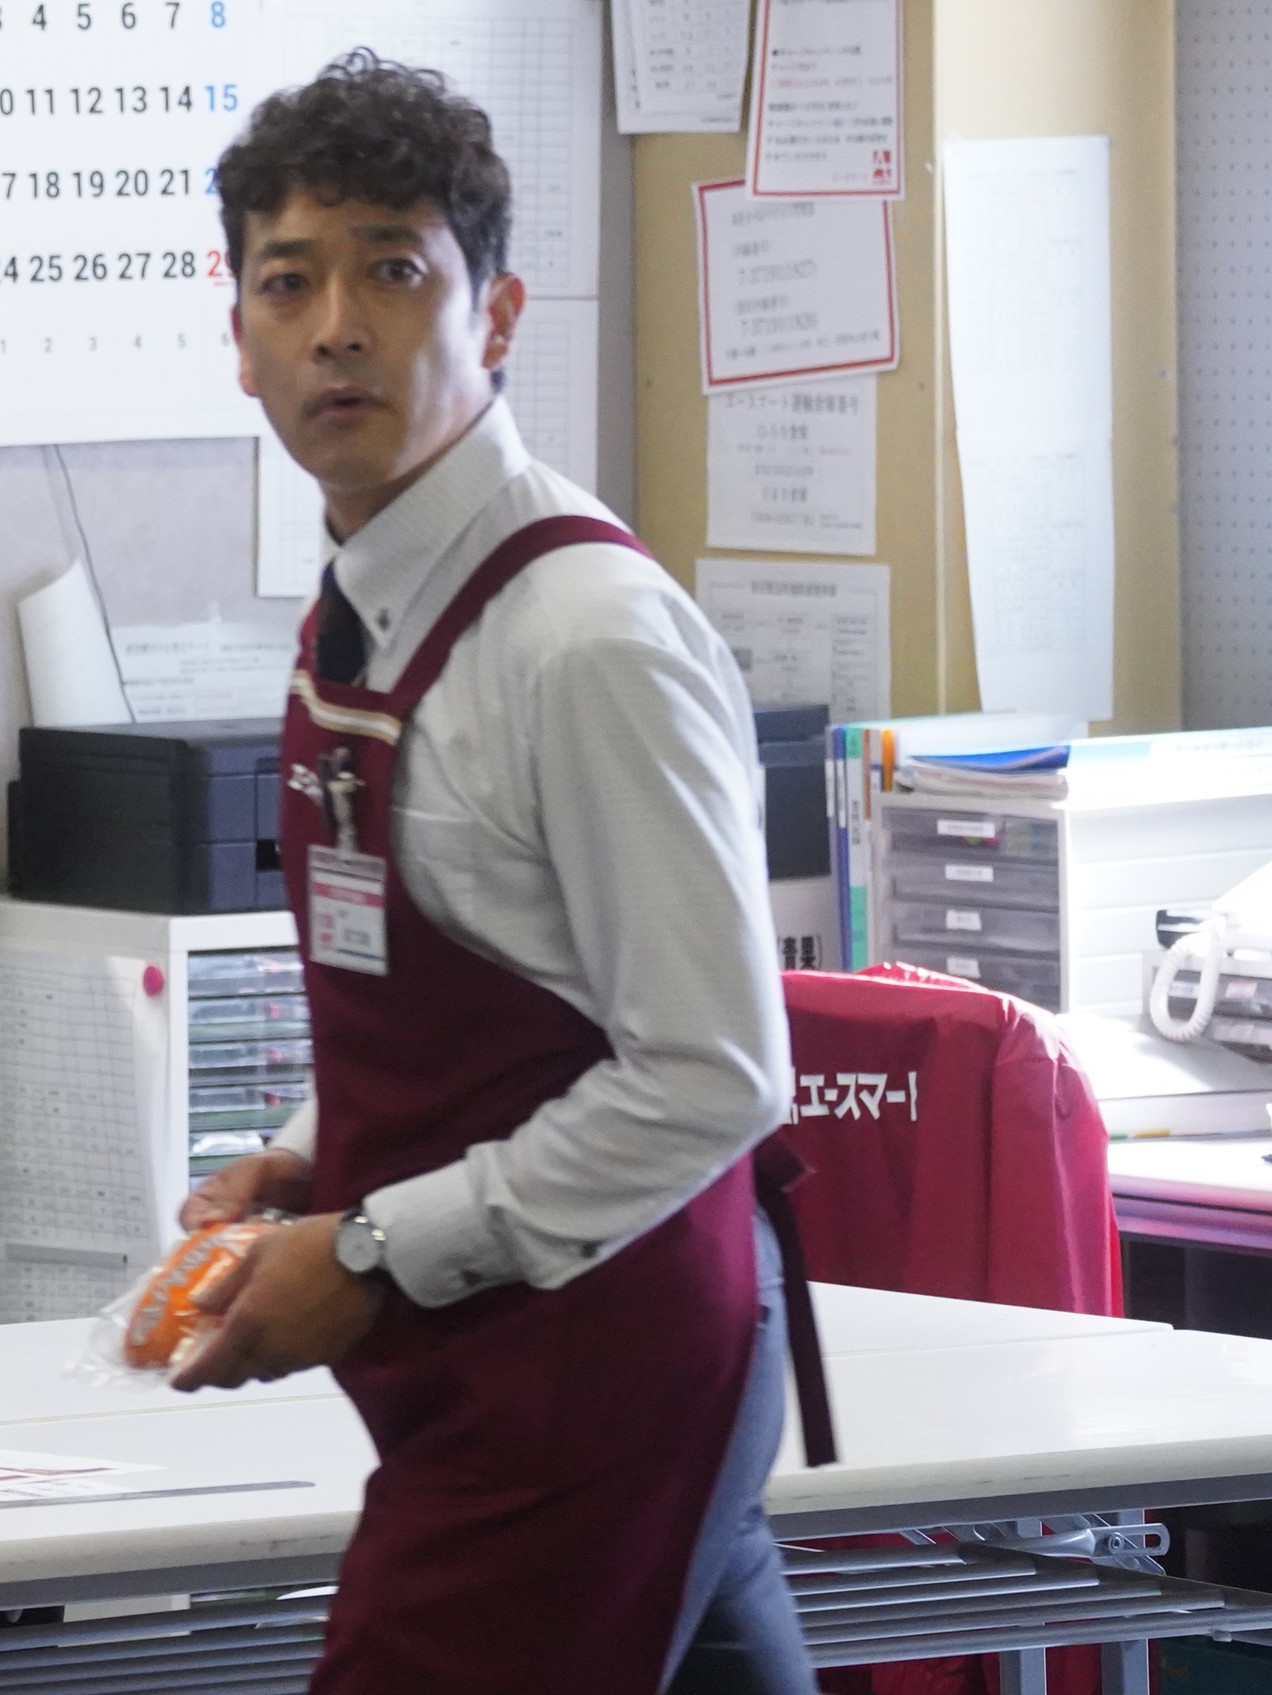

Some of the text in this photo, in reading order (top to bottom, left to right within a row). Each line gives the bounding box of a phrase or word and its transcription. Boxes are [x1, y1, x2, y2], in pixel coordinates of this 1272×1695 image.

[31, 3, 48, 31] 4
[77, 2, 92, 31] 5
[120, 2, 137, 30] 6
[165, 1, 181, 29] 7
[210, 0, 226, 29] 8
[25, 88, 55, 116] 11
[70, 86, 103, 115] 12
[114, 85, 148, 114] 13
[159, 85, 193, 113] 14
[205, 83, 238, 112] 15
[28, 171, 61, 199] 18
[72, 169, 105, 198] 19
[115, 169, 149, 197] 20
[160, 168, 190, 196] 21
[29, 254, 63, 283] 25
[73, 253, 108, 282] 26
[117, 252, 151, 280] 27
[162, 250, 197, 279] 28
[0, 339, 7, 354] 1
[43, 337, 53, 353] 2
[88, 336, 98, 352] 3
[133, 334, 143, 350] 4
[177, 333, 188, 349] 5
[221, 332, 230, 348] 6
